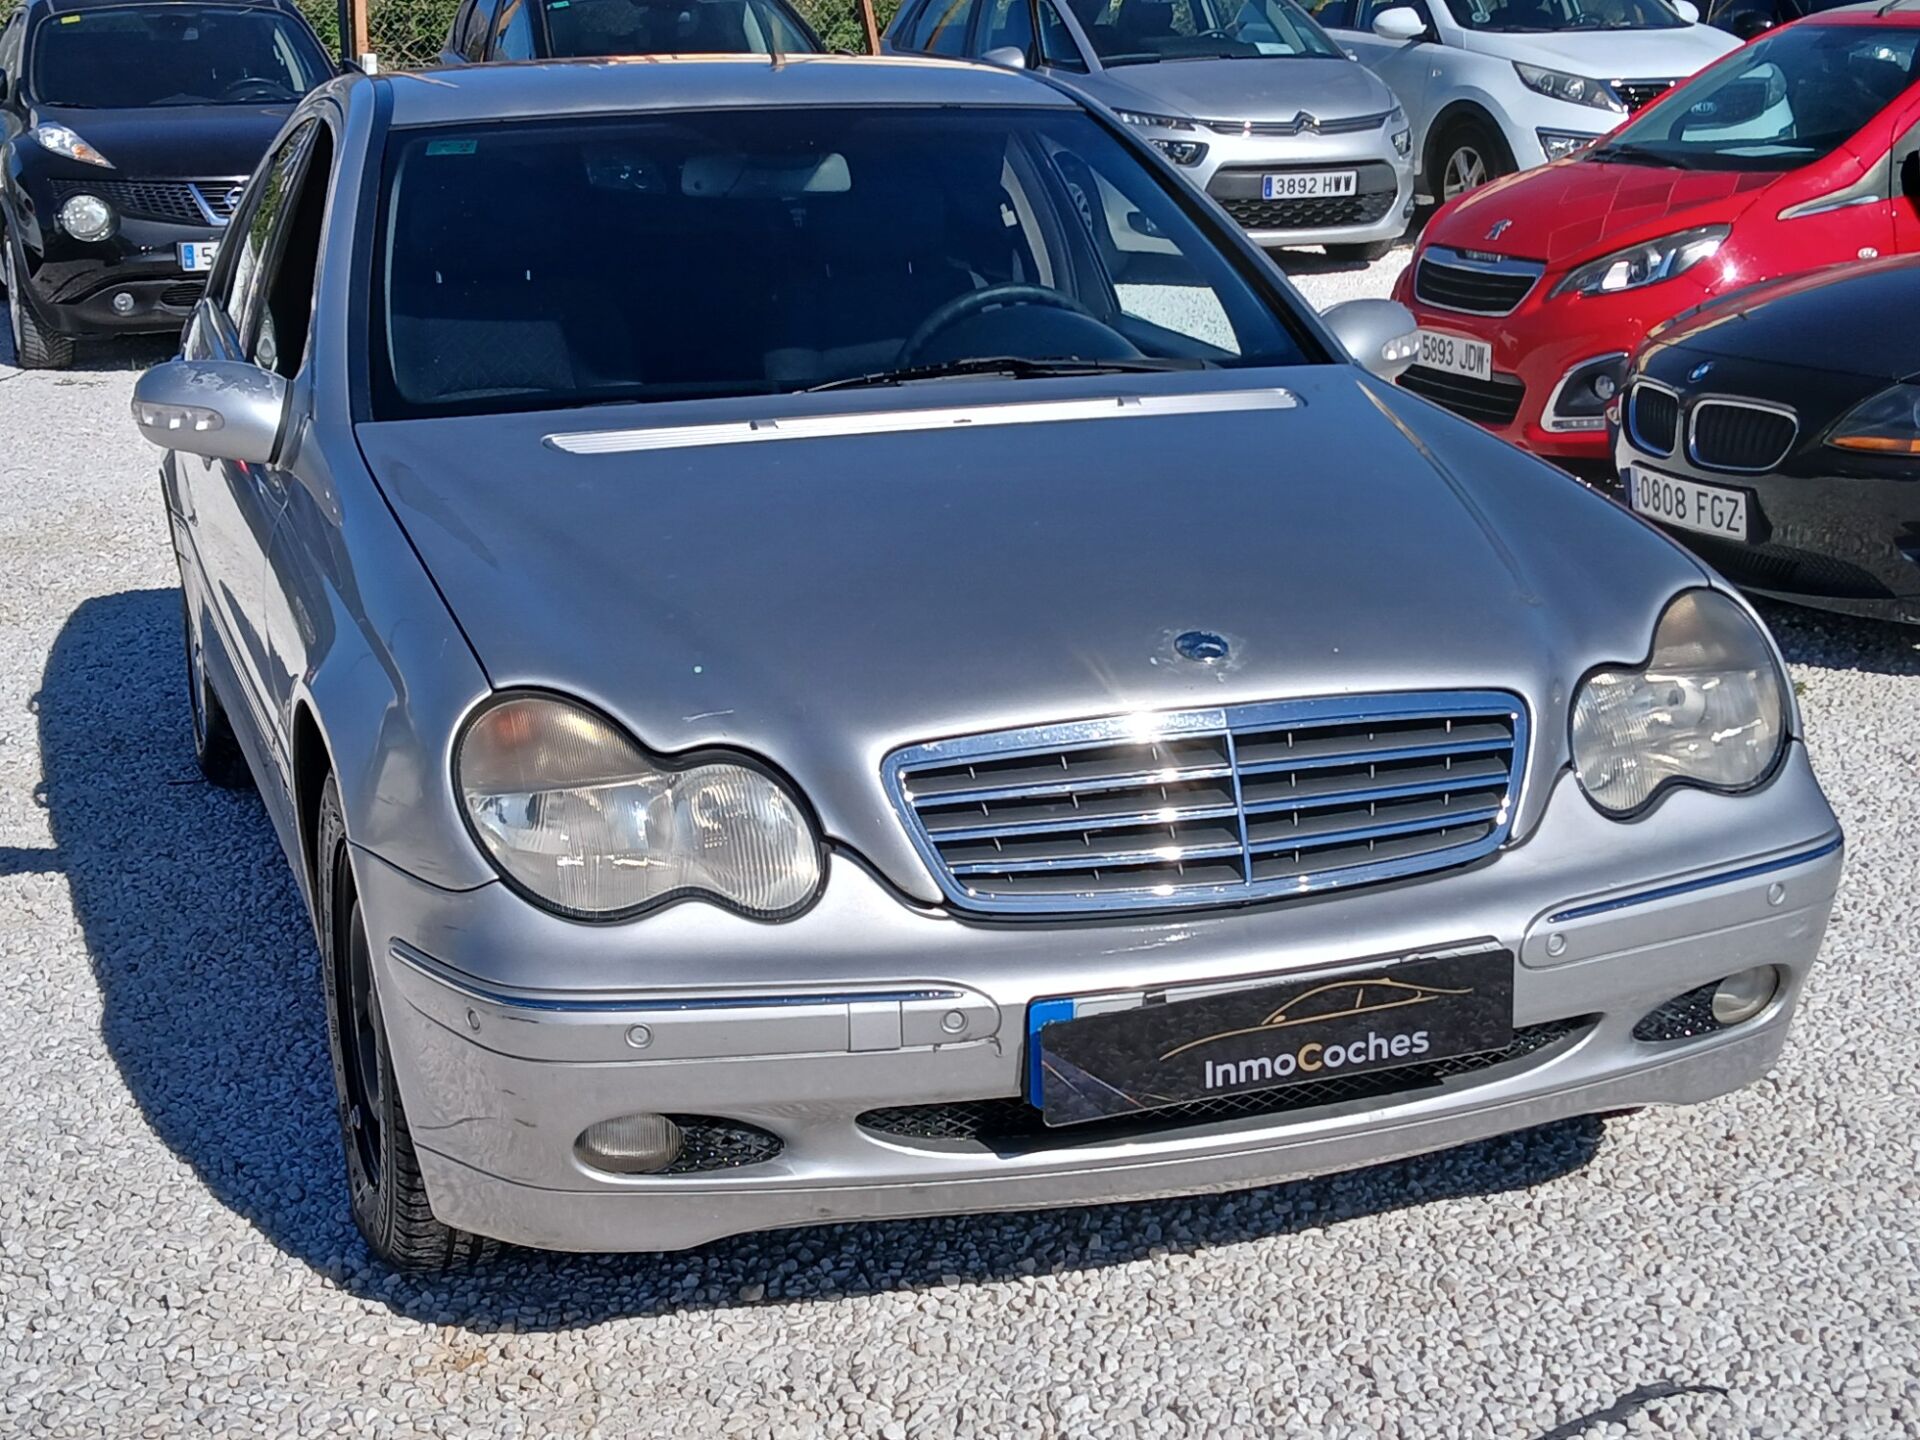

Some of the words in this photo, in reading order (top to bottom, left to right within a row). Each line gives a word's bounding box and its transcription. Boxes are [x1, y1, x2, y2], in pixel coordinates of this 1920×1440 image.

[1276, 177, 1318, 195] 3892
[1422, 334, 1454, 366] 5893
[1641, 475, 1687, 519] 0808
[1696, 490, 1740, 532] FGZ
[1205, 1030, 1430, 1089] InmoCoches
